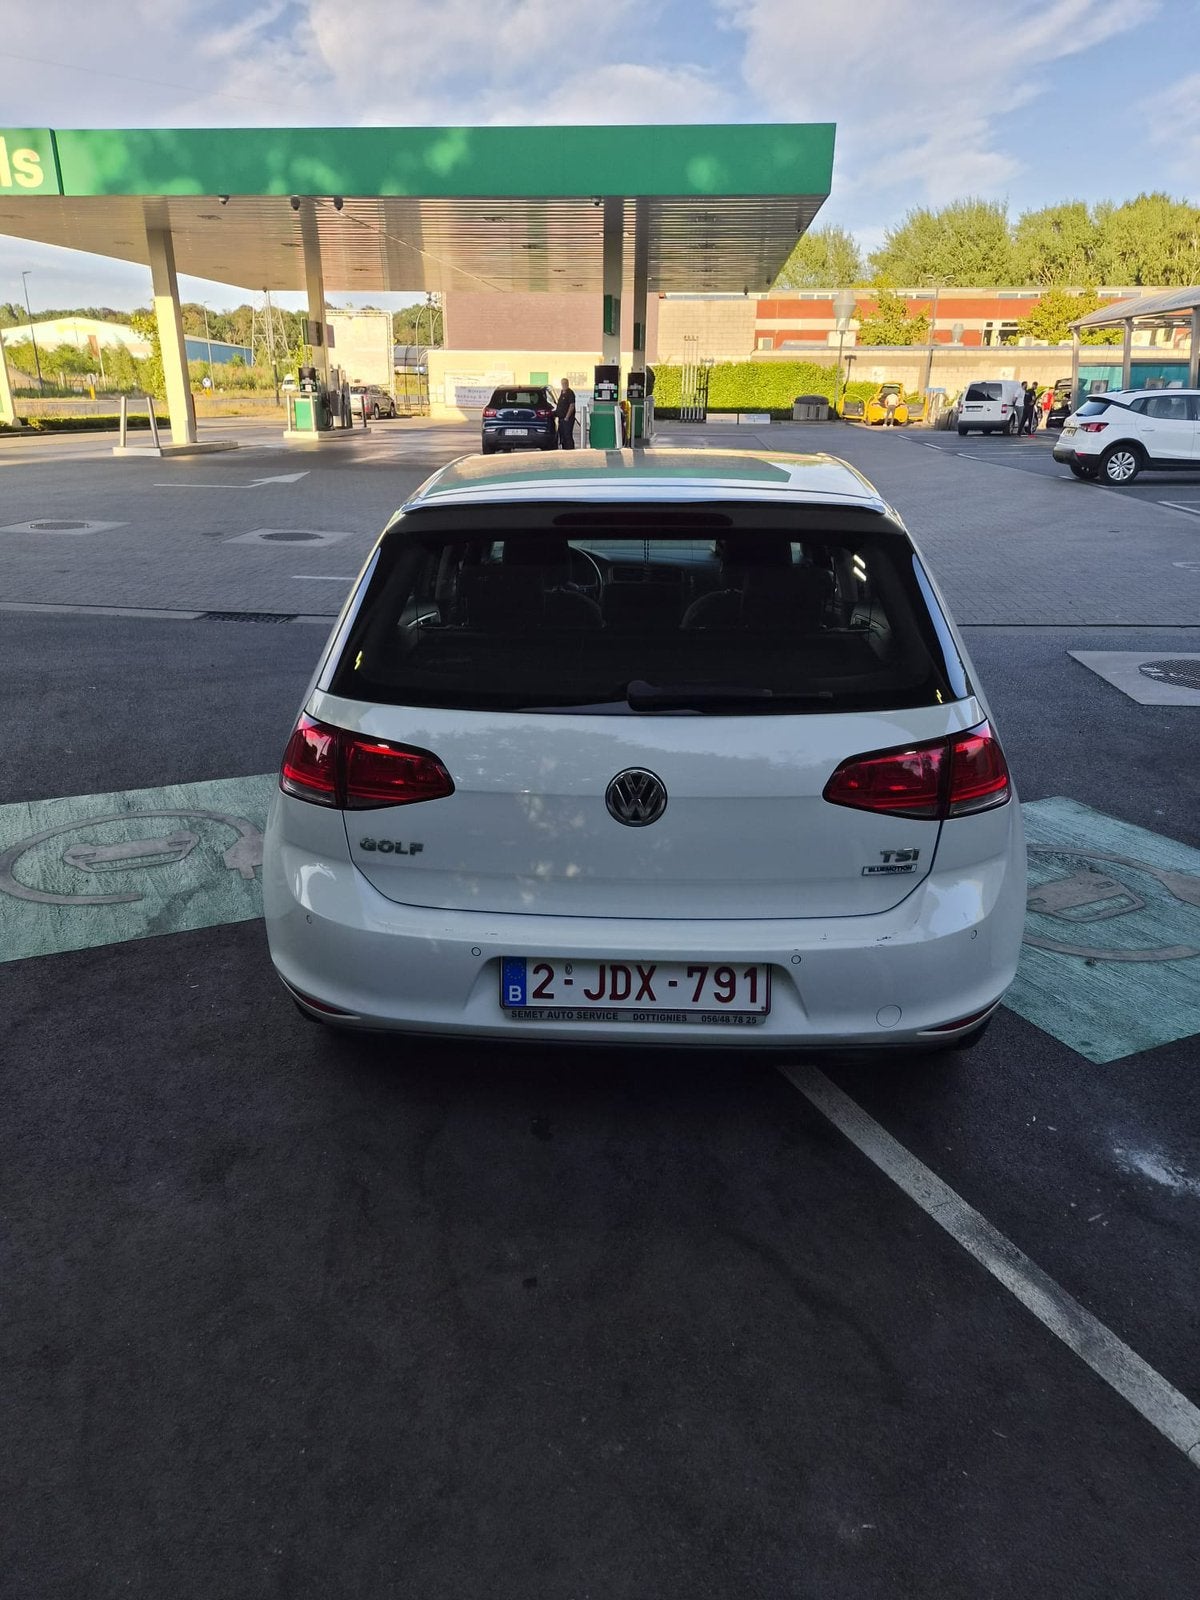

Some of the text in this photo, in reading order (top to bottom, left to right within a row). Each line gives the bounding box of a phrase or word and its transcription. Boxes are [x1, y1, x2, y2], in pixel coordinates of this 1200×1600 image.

[360, 837, 424, 856] GOLF
[880, 847, 920, 863] TSI
[508, 985, 522, 1002] B
[511, 1010, 757, 1025] SEMET AUTO SERVICE DOTTIGNIES 056/48 78 25
